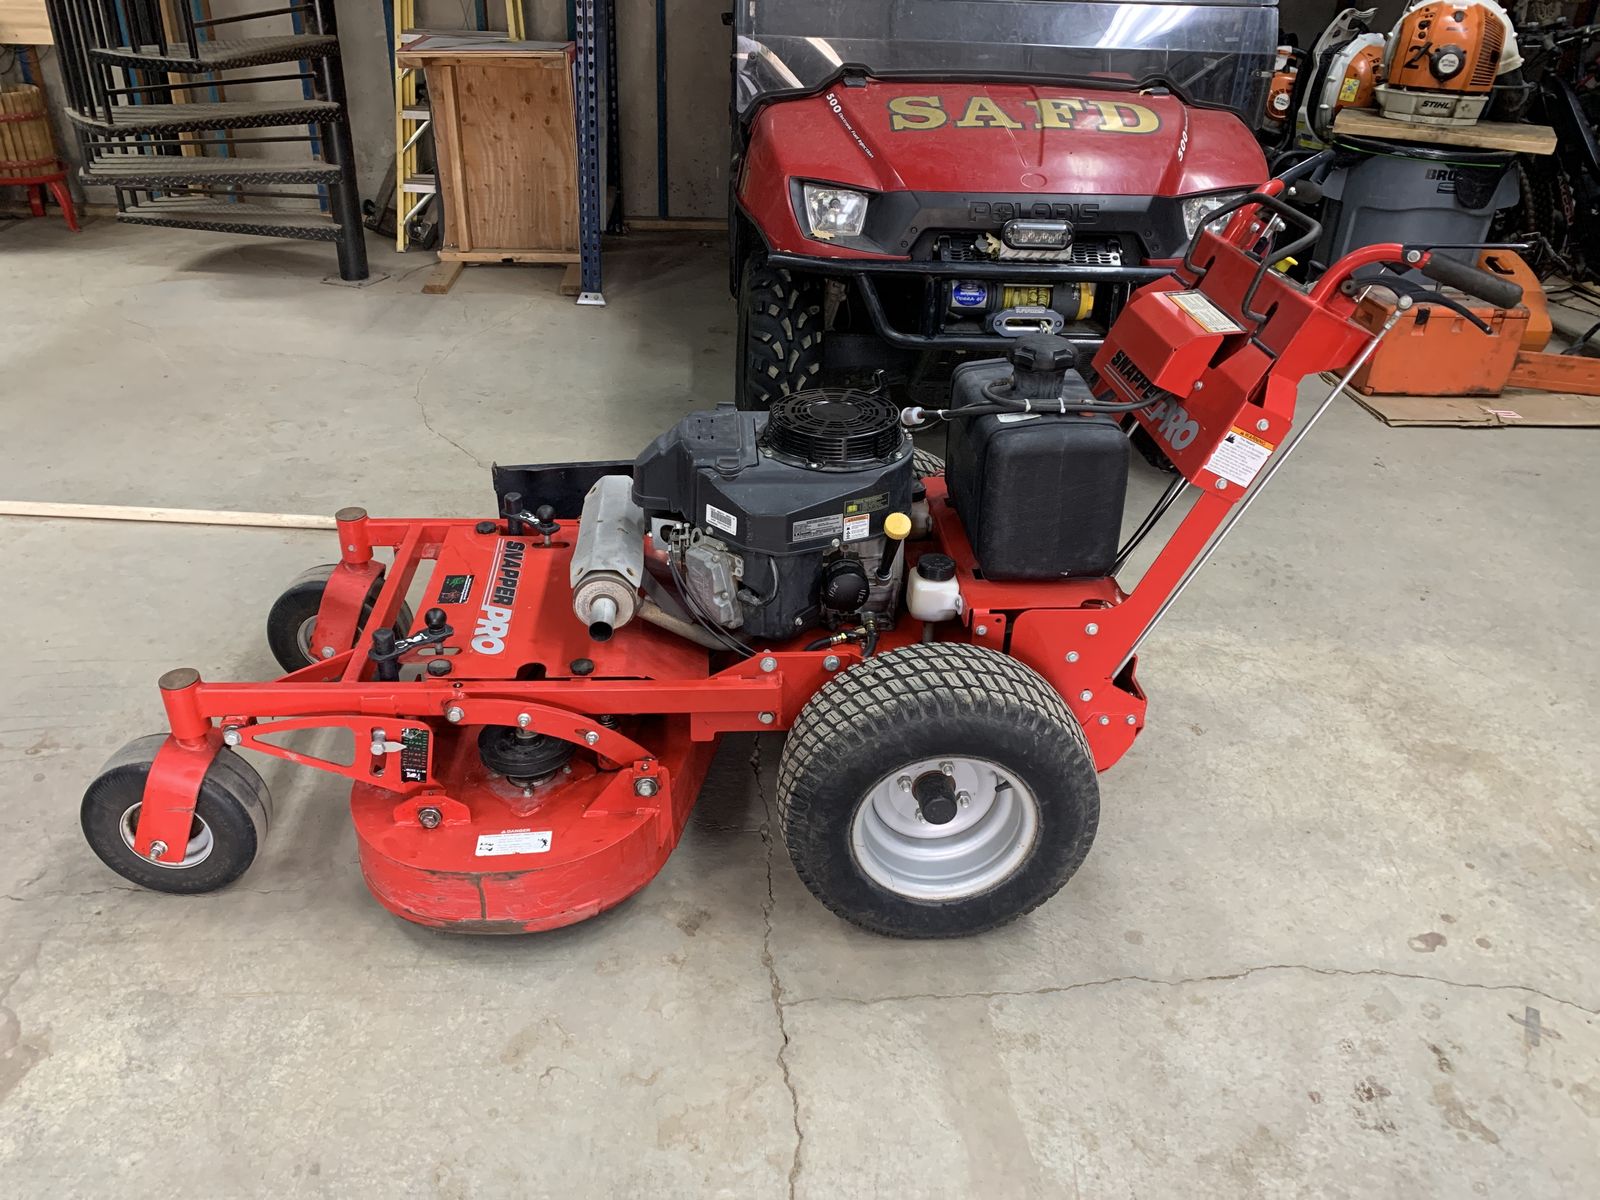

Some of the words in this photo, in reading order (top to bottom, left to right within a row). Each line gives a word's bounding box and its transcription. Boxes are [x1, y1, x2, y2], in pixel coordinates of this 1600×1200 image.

[826, 93, 842, 113] 500
[889, 95, 1160, 134] SAFD
[1421, 100, 1451, 109] STIHL
[1177, 130, 1188, 162] 500
[1424, 169, 1456, 180] BRU
[968, 201, 1100, 224] POLARIS
[1148, 396, 1199, 451] PRO
[493, 540, 526, 606] SNAPPER
[471, 605, 512, 655] PRO
